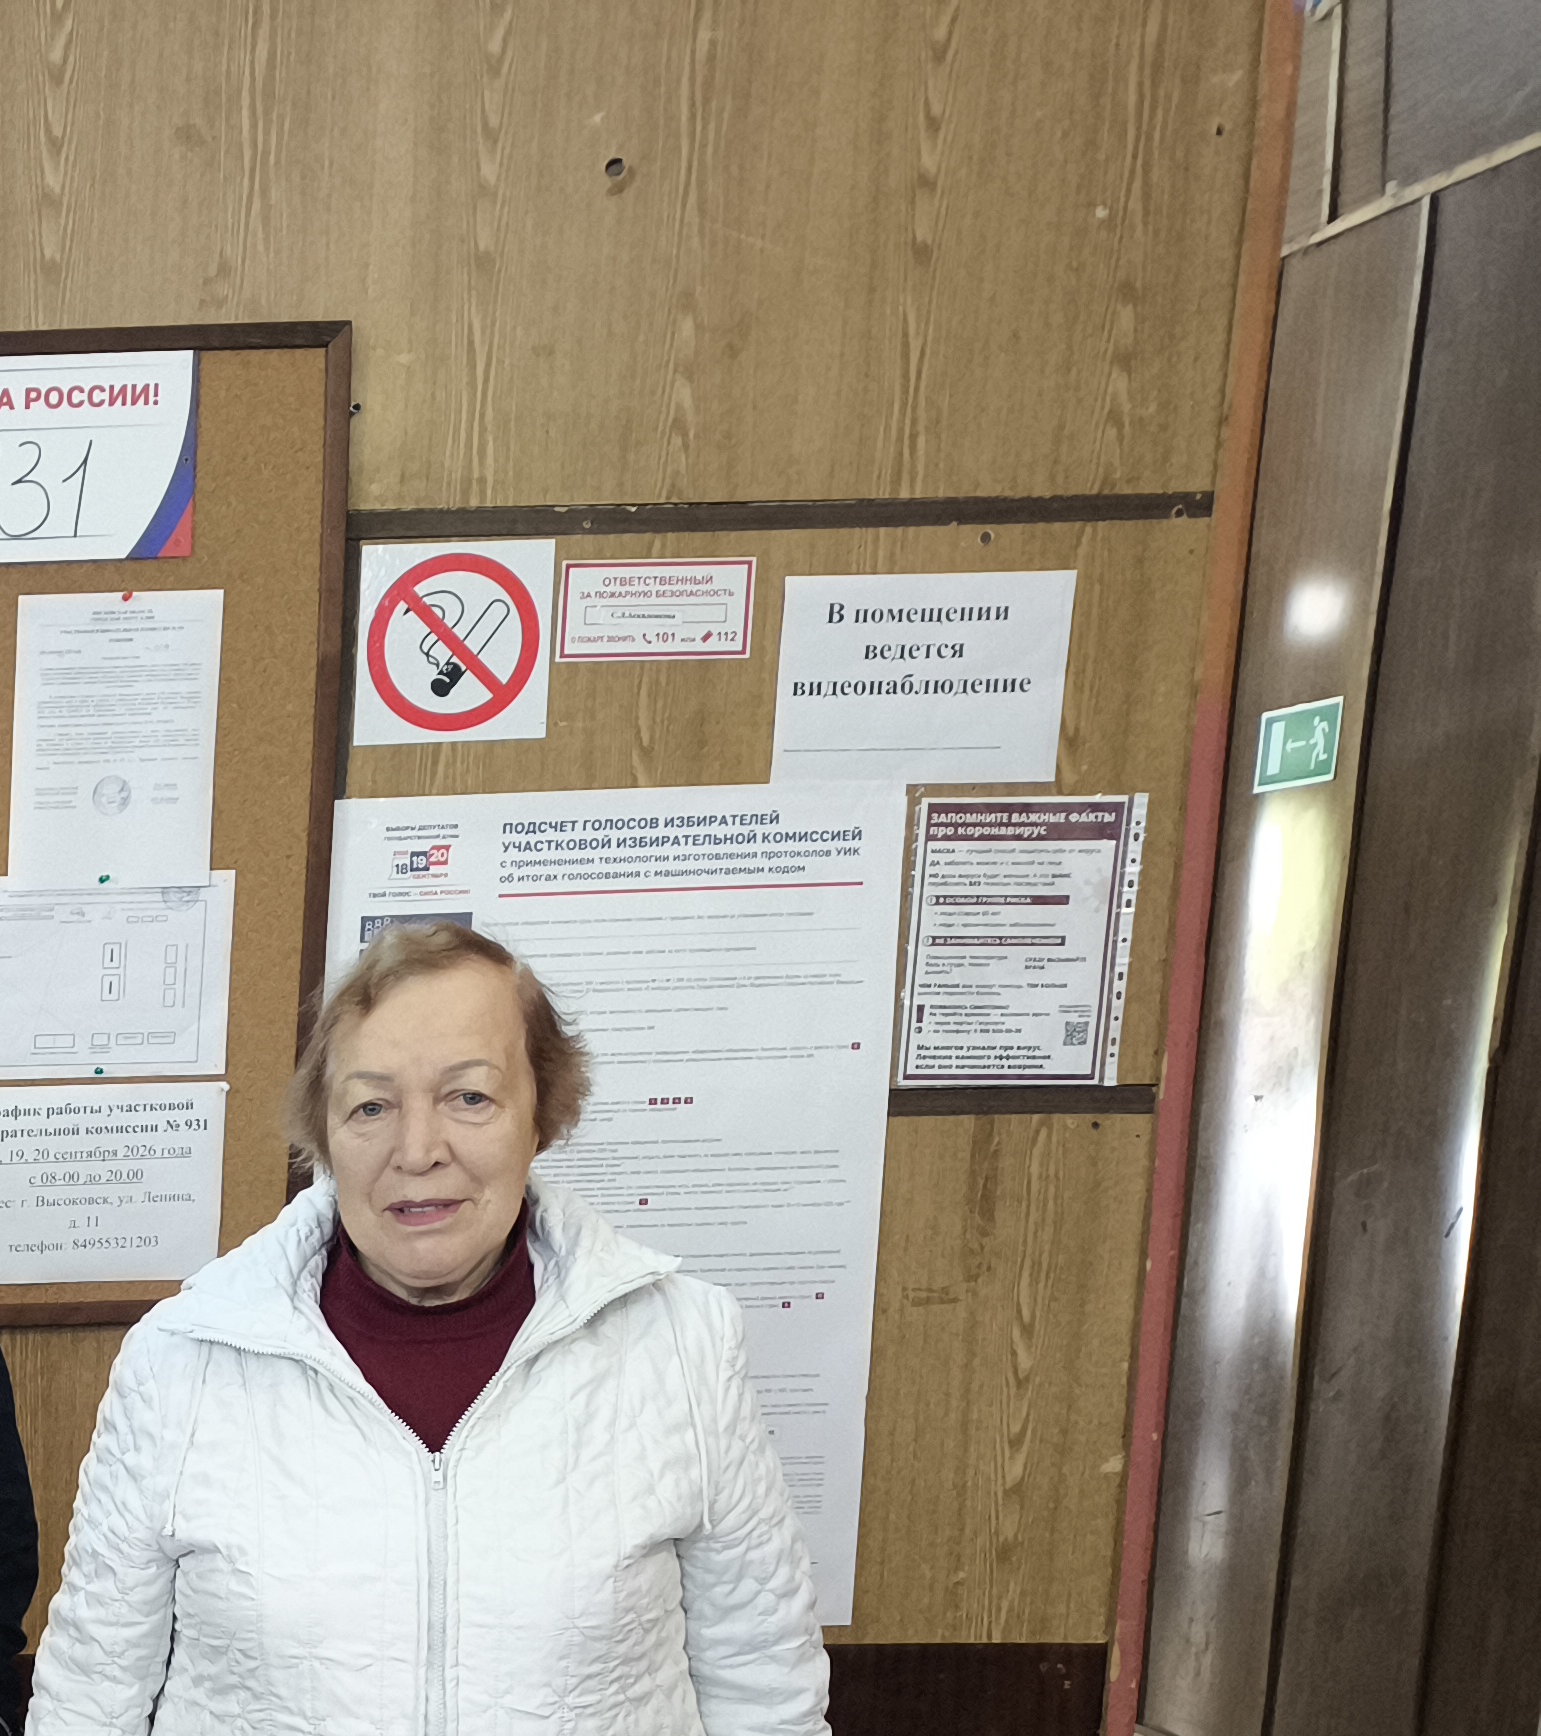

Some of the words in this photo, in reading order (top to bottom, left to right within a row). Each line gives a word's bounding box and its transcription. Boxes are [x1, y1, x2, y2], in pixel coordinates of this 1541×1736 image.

[24, 382, 160, 410] РОССИИ!
[602, 573, 713, 587] ОТВЕТСТВЕННЫЙ
[580, 591, 592, 599] ЗА
[595, 590, 652, 599] ПОЖАРНУЮ
[655, 588, 734, 598] БЕЗОПАСНОСТЬ
[826, 602, 845, 624] В
[854, 605, 1010, 625] помещении
[655, 632, 676, 643] 101
[717, 631, 737, 642] 112
[863, 642, 965, 662] ведется
[792, 673, 1032, 699] видеонаблюдение
[502, 820, 578, 835] ПОДСЧЕТ
[583, 816, 659, 831] ГОЛОСОВ
[664, 810, 780, 828] ИЗБИРАТЕЛЕЙ
[930, 812, 1009, 824] ЗАПОМНИТЕ
[1012, 812, 1066, 823] ВАЖНЫЕ
[1069, 811, 1116, 823] ФАКТЫ
[502, 835, 612, 853] УЧАСТКОВОЙ
[617, 829, 757, 849] ИЗБИРАТЕЛЬНОЙ
[761, 827, 862, 844] КОМИССИЕЙ
[929, 826, 954, 838] про
[957, 825, 1047, 838] коронавирус
[412, 856, 426, 868] 19
[429, 849, 447, 861] 20
[500, 860, 507, 868] с
[511, 857, 595, 869] применением
[599, 854, 670, 865] технологии
[673, 851, 758, 862] изготовления
[761, 848, 831, 860] протоколов
[835, 847, 861, 857] УИК
[395, 863, 408, 875] 18
[499, 873, 514, 883] об
[517, 873, 558, 883] итогах
[562, 869, 641, 881] голосования
[644, 869, 651, 878] с
[654, 864, 765, 877] машиночитаемым
[768, 865, 805, 875] кодом
[46, 1102, 101, 1118] работы
[107, 1098, 194, 1116] участковой
[85, 1122, 159, 1135] комиссии
[163, 1119, 180, 1133] №
[185, 1118, 208, 1132] 931
[8, 1149, 29, 1163] 19,
[34, 1149, 50, 1161] 20
[53, 1146, 118, 1162] сентября
[122, 1144, 157, 1158] 2026
[161, 1145, 192, 1158] года
[29, 1175, 36, 1185] с
[41, 1171, 80, 1185] 08-00
[84, 1172, 101, 1184] до
[105, 1168, 144, 1182] 20.00
[35, 1194, 113, 1208] Высоковск,
[141, 1191, 196, 1205] Ленина,
[68, 1218, 80, 1230] д.
[86, 1216, 100, 1228] 11
[72, 1235, 159, 1250] 84955321203
